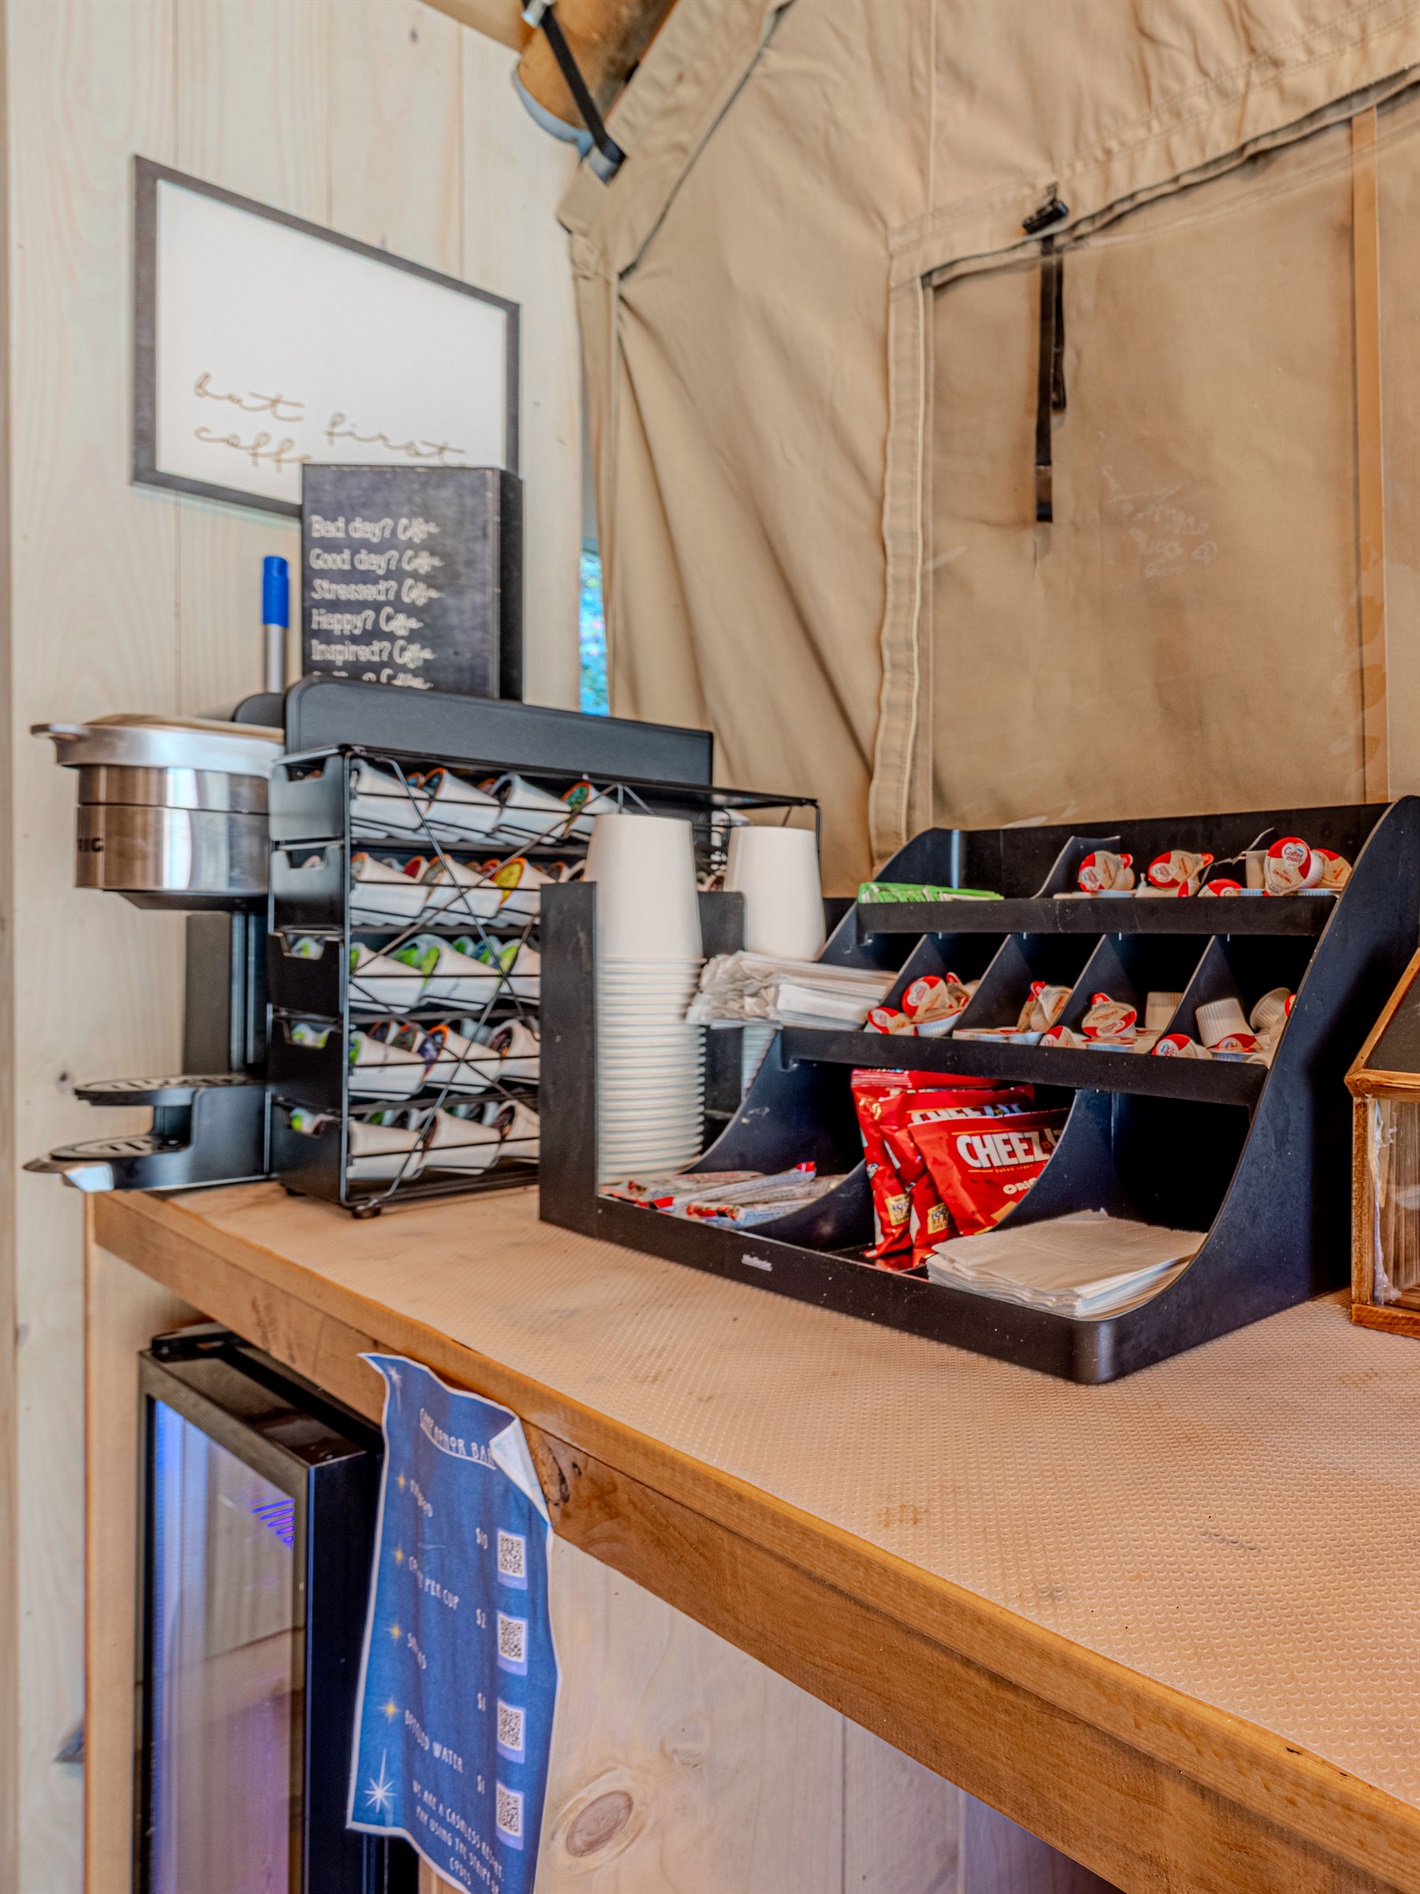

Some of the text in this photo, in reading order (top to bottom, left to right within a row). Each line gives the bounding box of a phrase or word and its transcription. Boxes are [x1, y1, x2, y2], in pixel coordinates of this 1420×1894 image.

[194, 372, 466, 467] but first
[194, 427, 313, 473] coffe
[311, 515, 346, 538] Bad
[349, 517, 394, 543] day?
[310, 548, 351, 570] Good
[354, 549, 399, 575] day?
[311, 579, 398, 601] Stressed?
[311, 609, 375, 635] Happy?
[311, 640, 391, 666] Inspired?
[424, 1578, 442, 1599] PER
[443, 1588, 460, 1610] CUP
[432, 1741, 463, 1773] WATER
[429, 1818, 452, 1846] USING
[446, 1808, 480, 1848] CASHLESS
